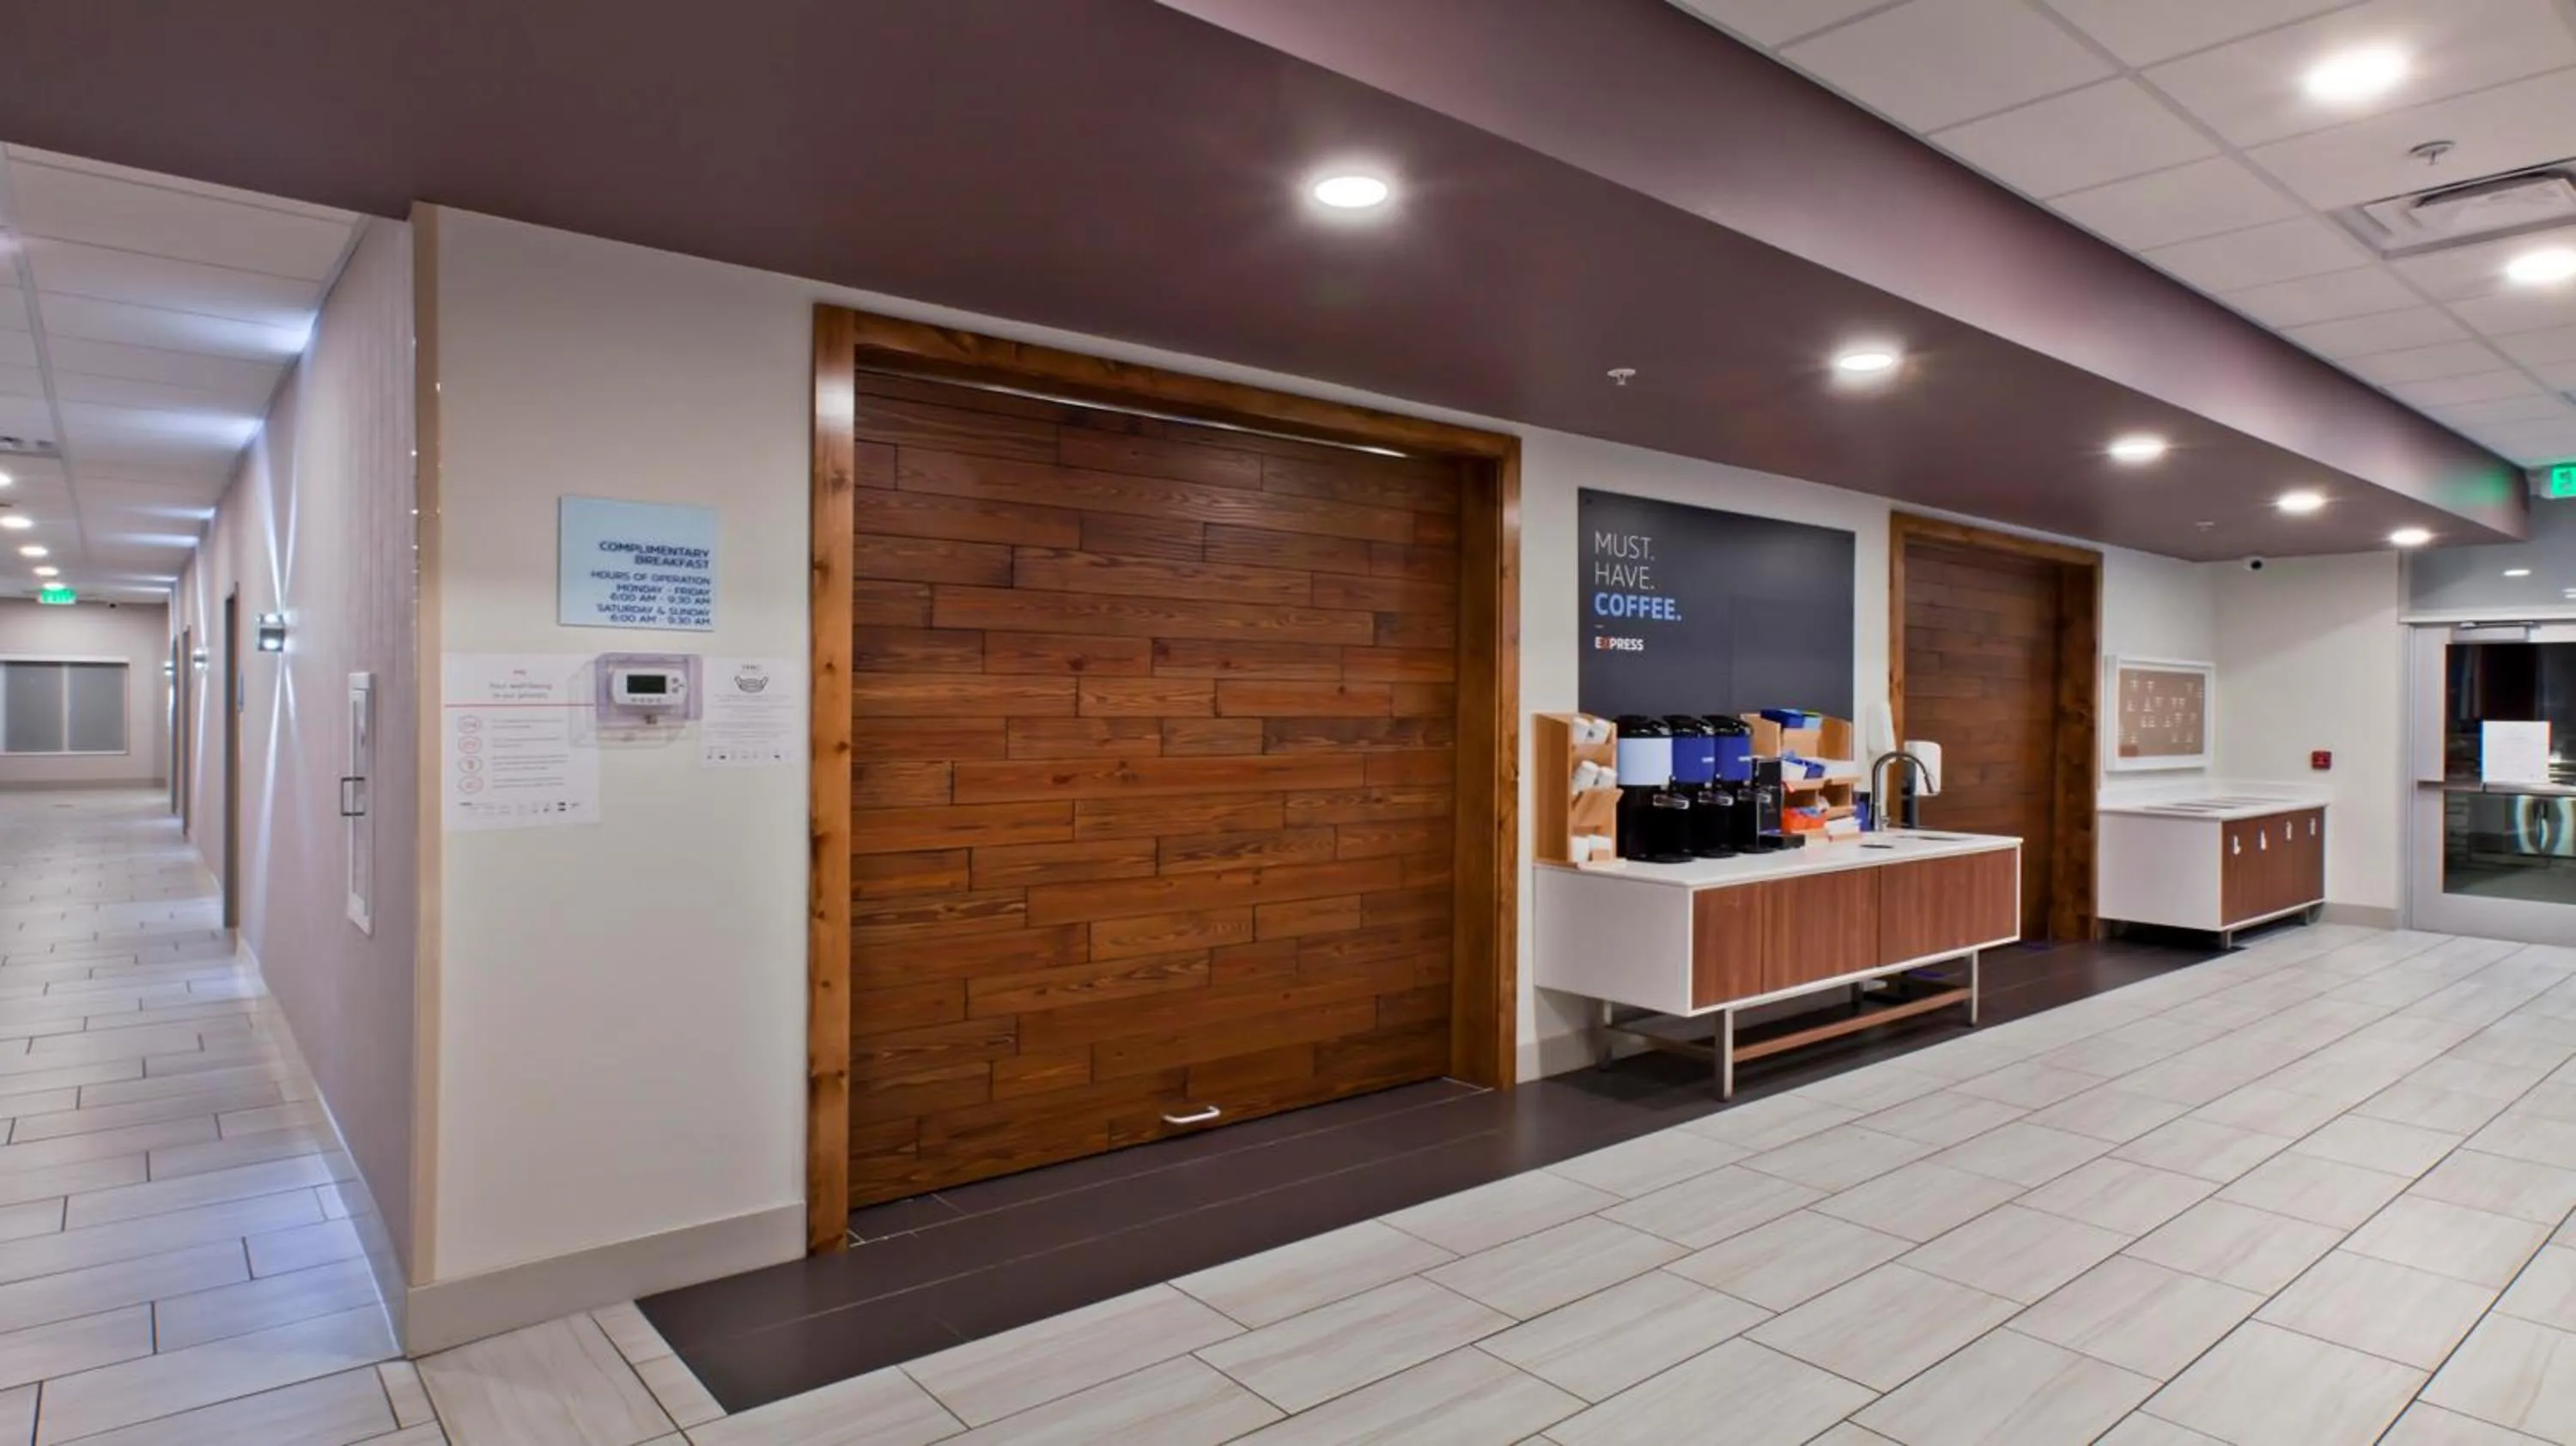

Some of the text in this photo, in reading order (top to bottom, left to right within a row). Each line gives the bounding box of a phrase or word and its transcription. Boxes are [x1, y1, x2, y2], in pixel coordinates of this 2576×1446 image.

[599, 540, 709, 558] COMPLIMENTARY
[1595, 531, 1656, 561] MUST.
[635, 555, 709, 569] BREAKFAST
[591, 570, 711, 585] HOURS OF OPERATION
[1595, 561, 1656, 590] HAVE.
[617, 584, 663, 594] MONDAY
[674, 586, 711, 596] FRIDAY
[597, 603, 711, 617] SATURDAY & SUNDAY
[1594, 592, 1682, 622] COFFEE.
[639, 615, 657, 623] AM
[695, 617, 711, 625] AM
[1595, 636, 1644, 651] EXPRESS
